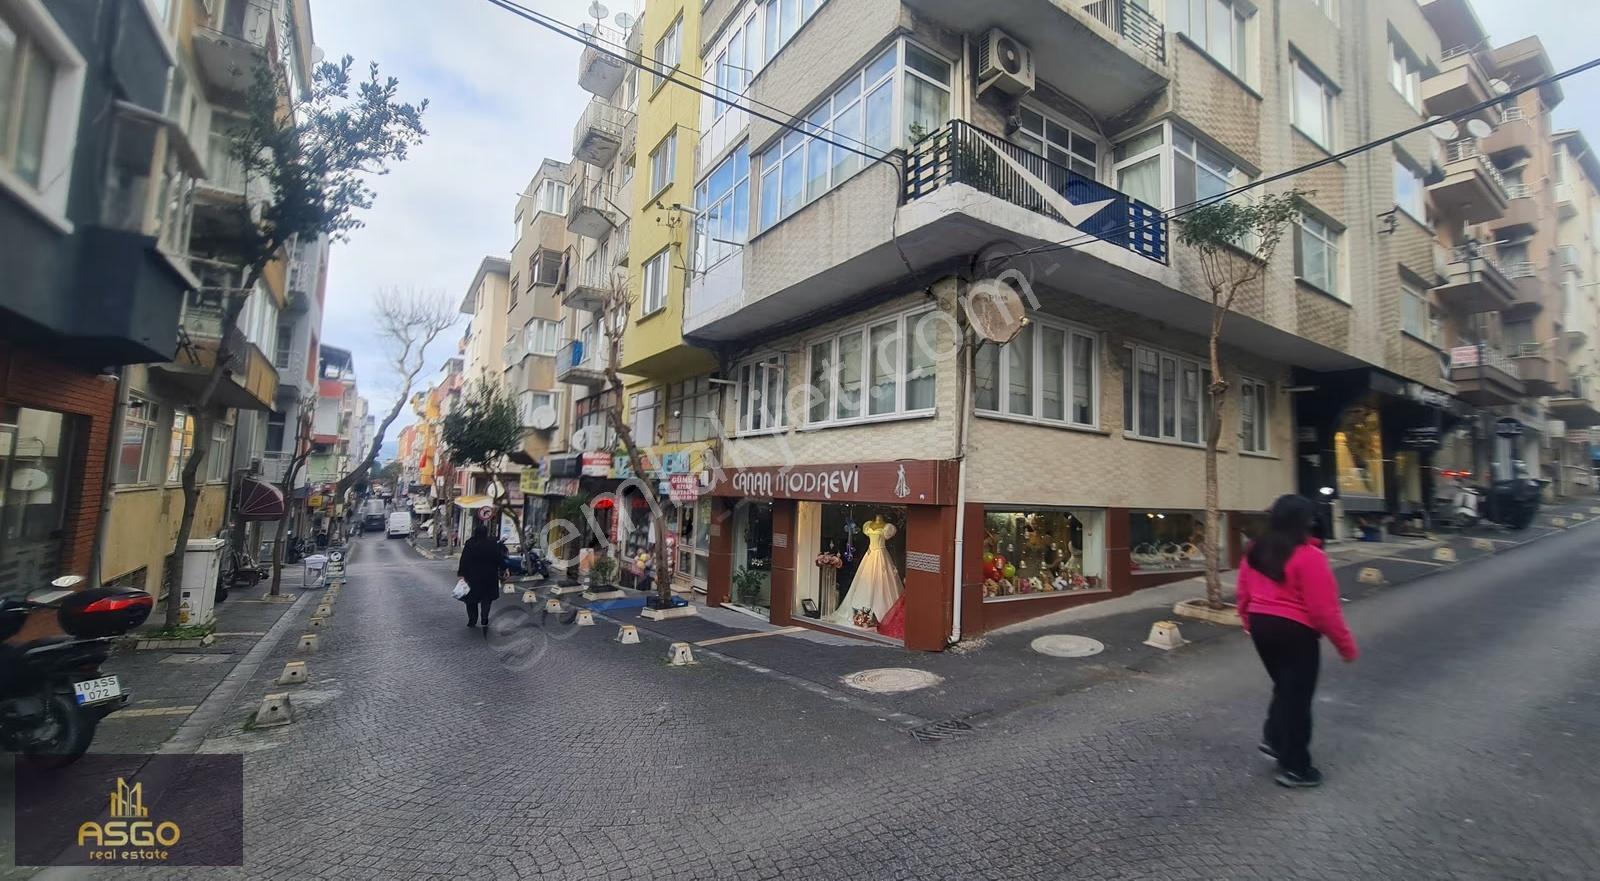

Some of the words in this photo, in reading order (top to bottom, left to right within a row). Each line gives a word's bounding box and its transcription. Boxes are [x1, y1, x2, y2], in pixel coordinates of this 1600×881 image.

[732, 472, 773, 497] CANAN
[77, 682, 90, 692] 10
[93, 677, 116, 689] ASS
[89, 689, 109, 700] 072
